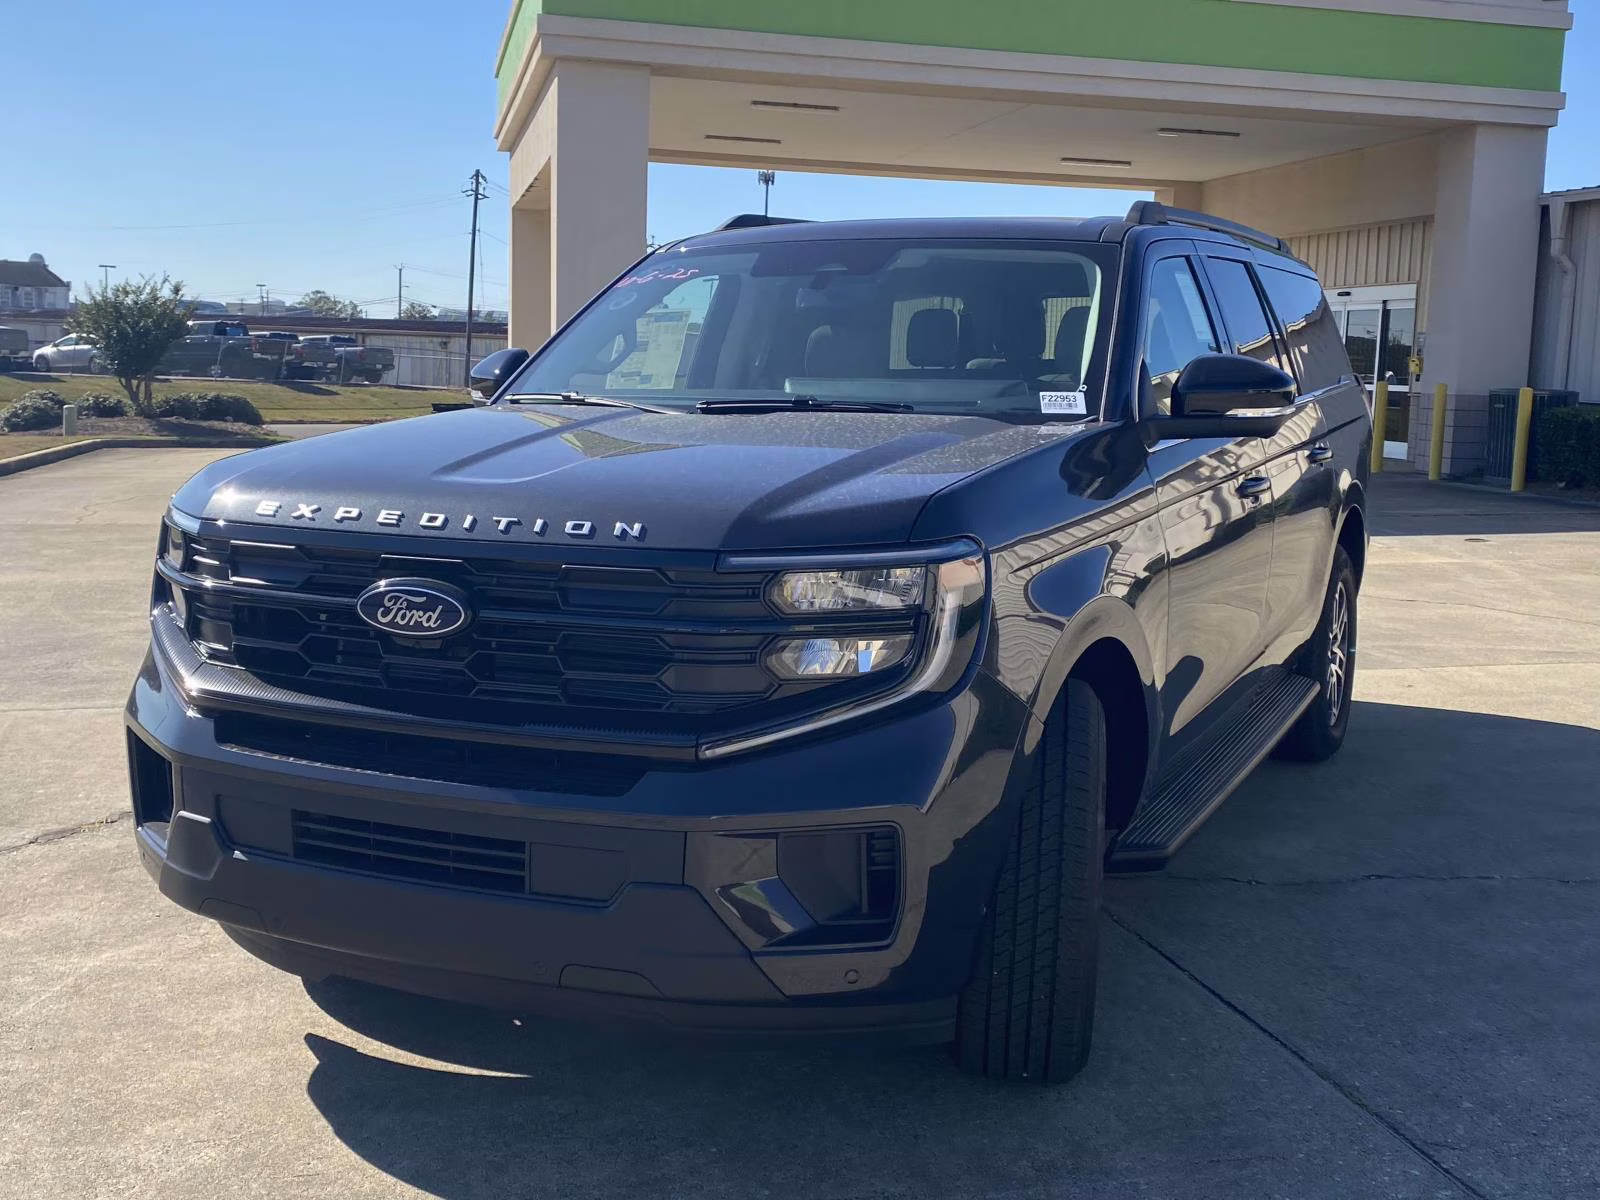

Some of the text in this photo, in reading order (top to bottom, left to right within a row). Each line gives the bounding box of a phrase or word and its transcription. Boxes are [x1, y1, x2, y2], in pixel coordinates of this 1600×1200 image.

[1041, 394, 1077, 403] F22953
[255, 500, 644, 539] EXPEDITION
[377, 592, 443, 628] Ford
